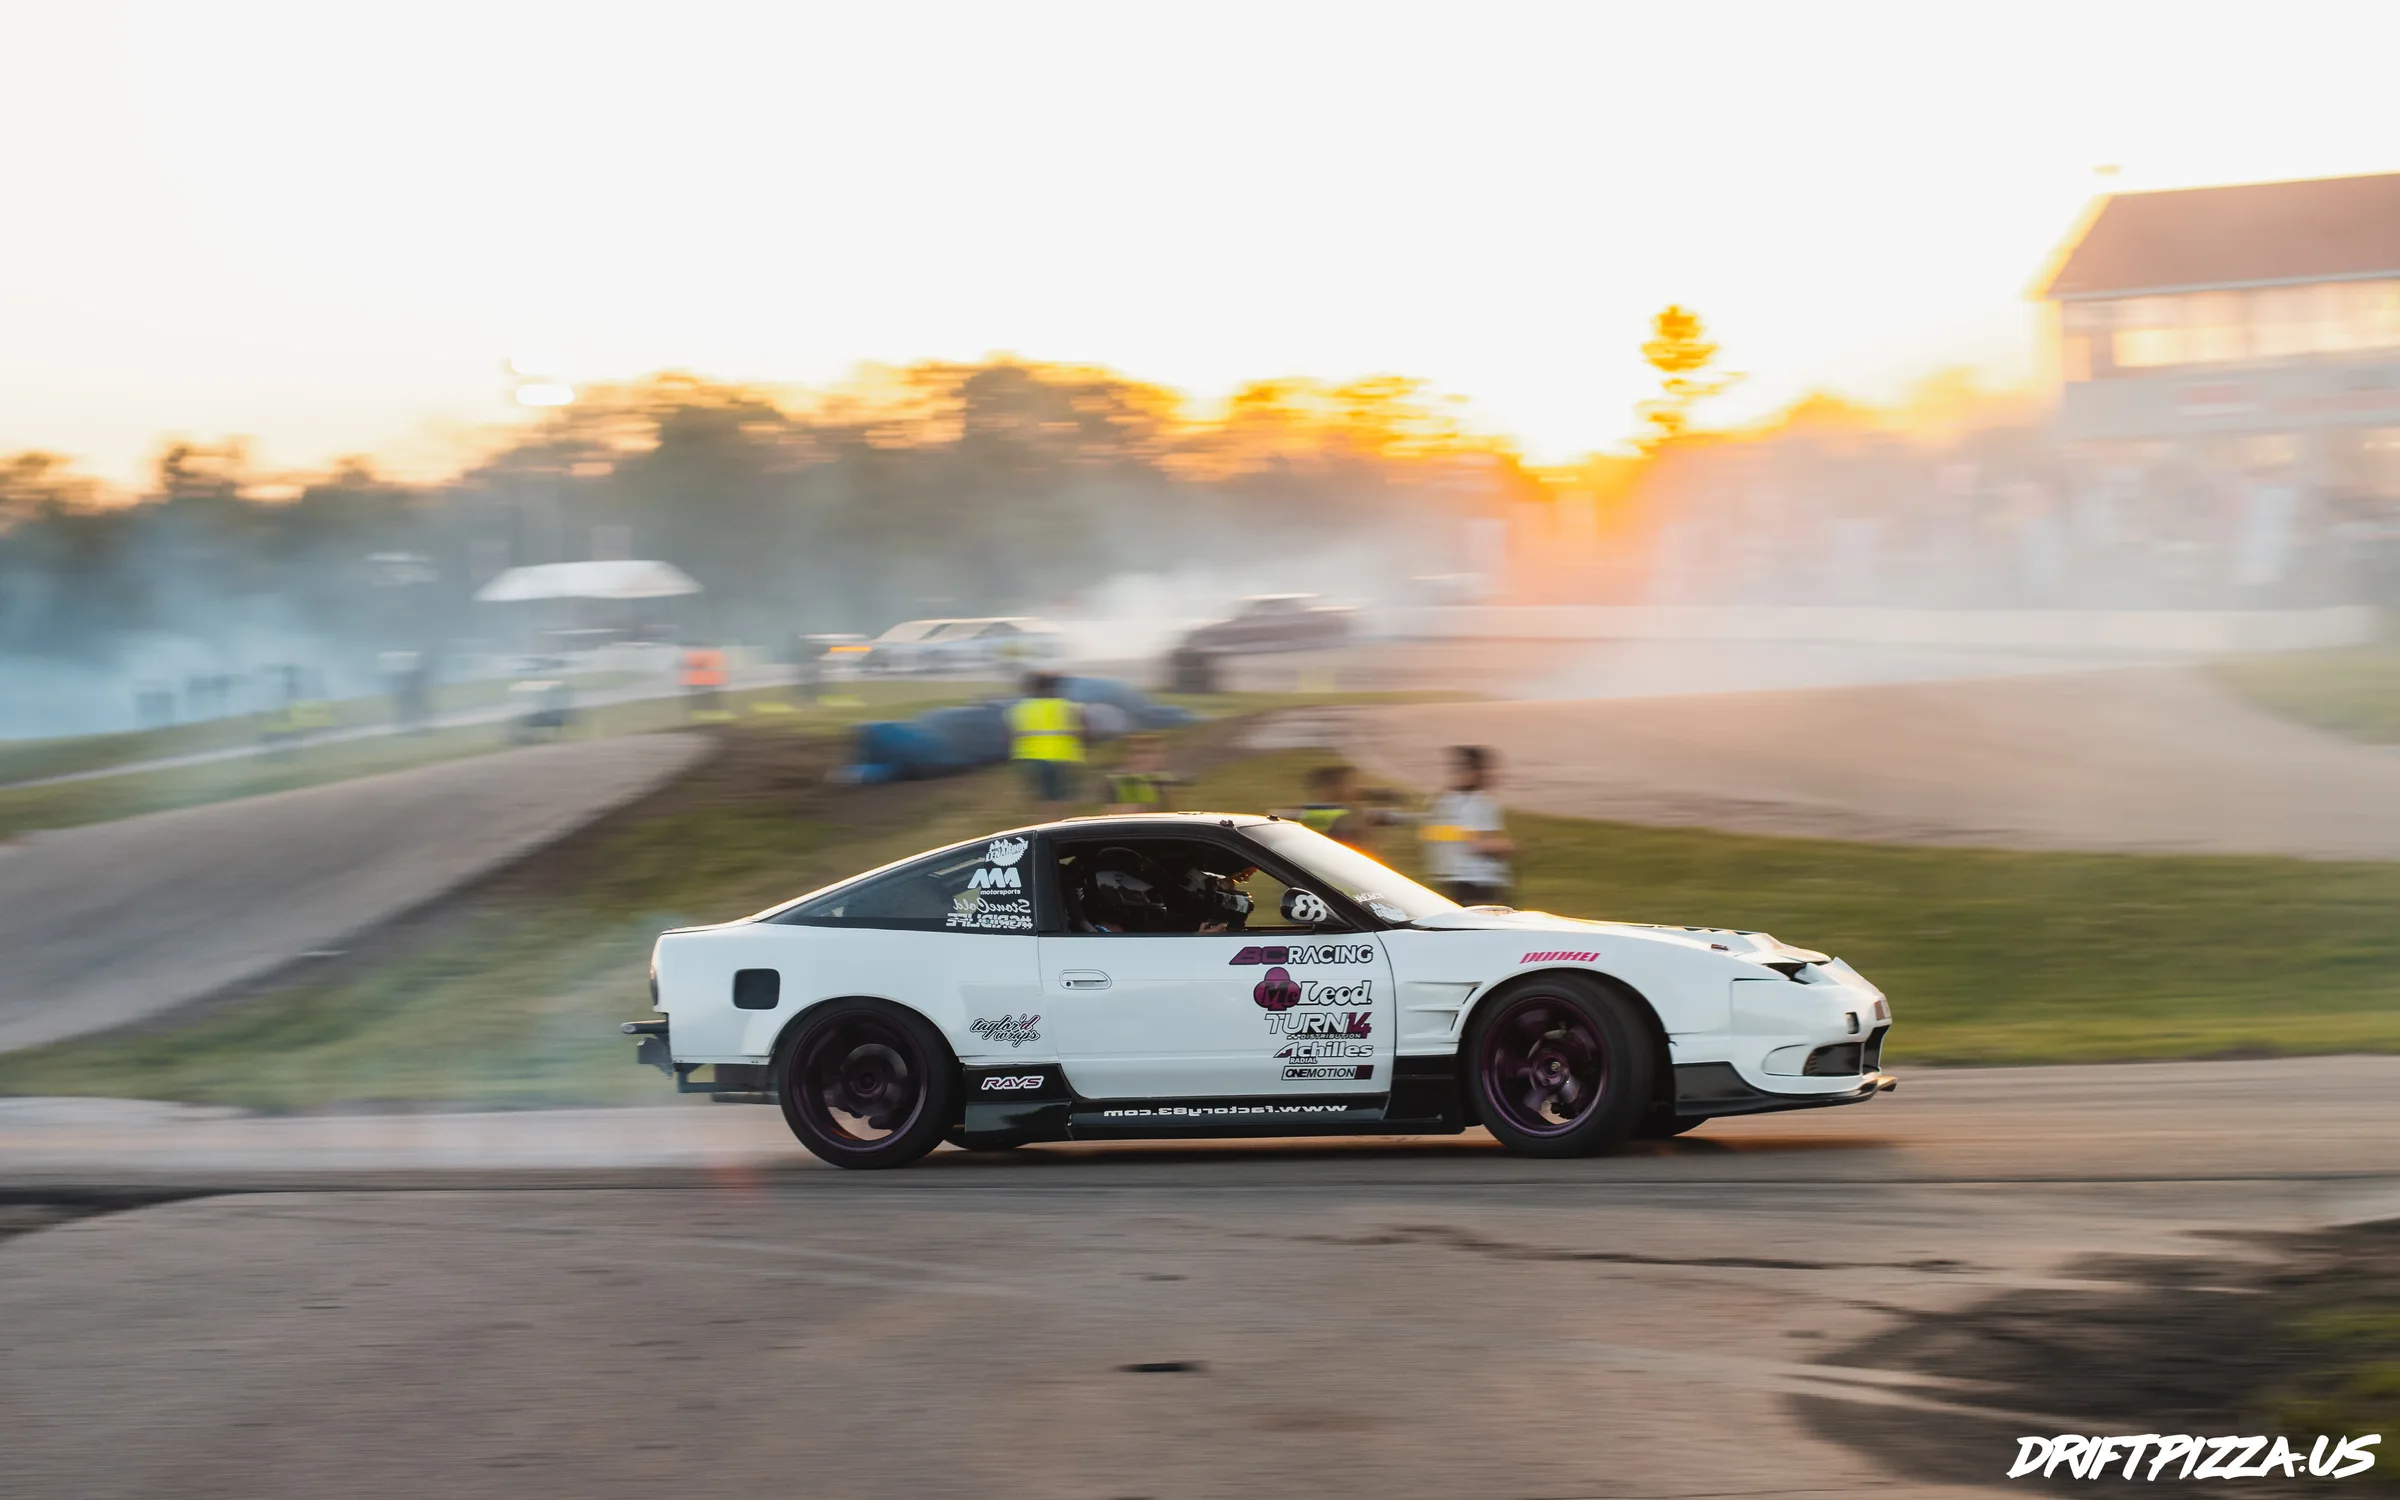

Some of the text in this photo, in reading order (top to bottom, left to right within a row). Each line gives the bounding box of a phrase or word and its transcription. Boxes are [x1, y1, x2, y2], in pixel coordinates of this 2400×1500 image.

[993, 1029, 1041, 1048] wraps
[1273, 1041, 1374, 1058] Achilles
[1289, 1056, 1318, 1064] RADIAL
[981, 1076, 1044, 1090] RAYS
